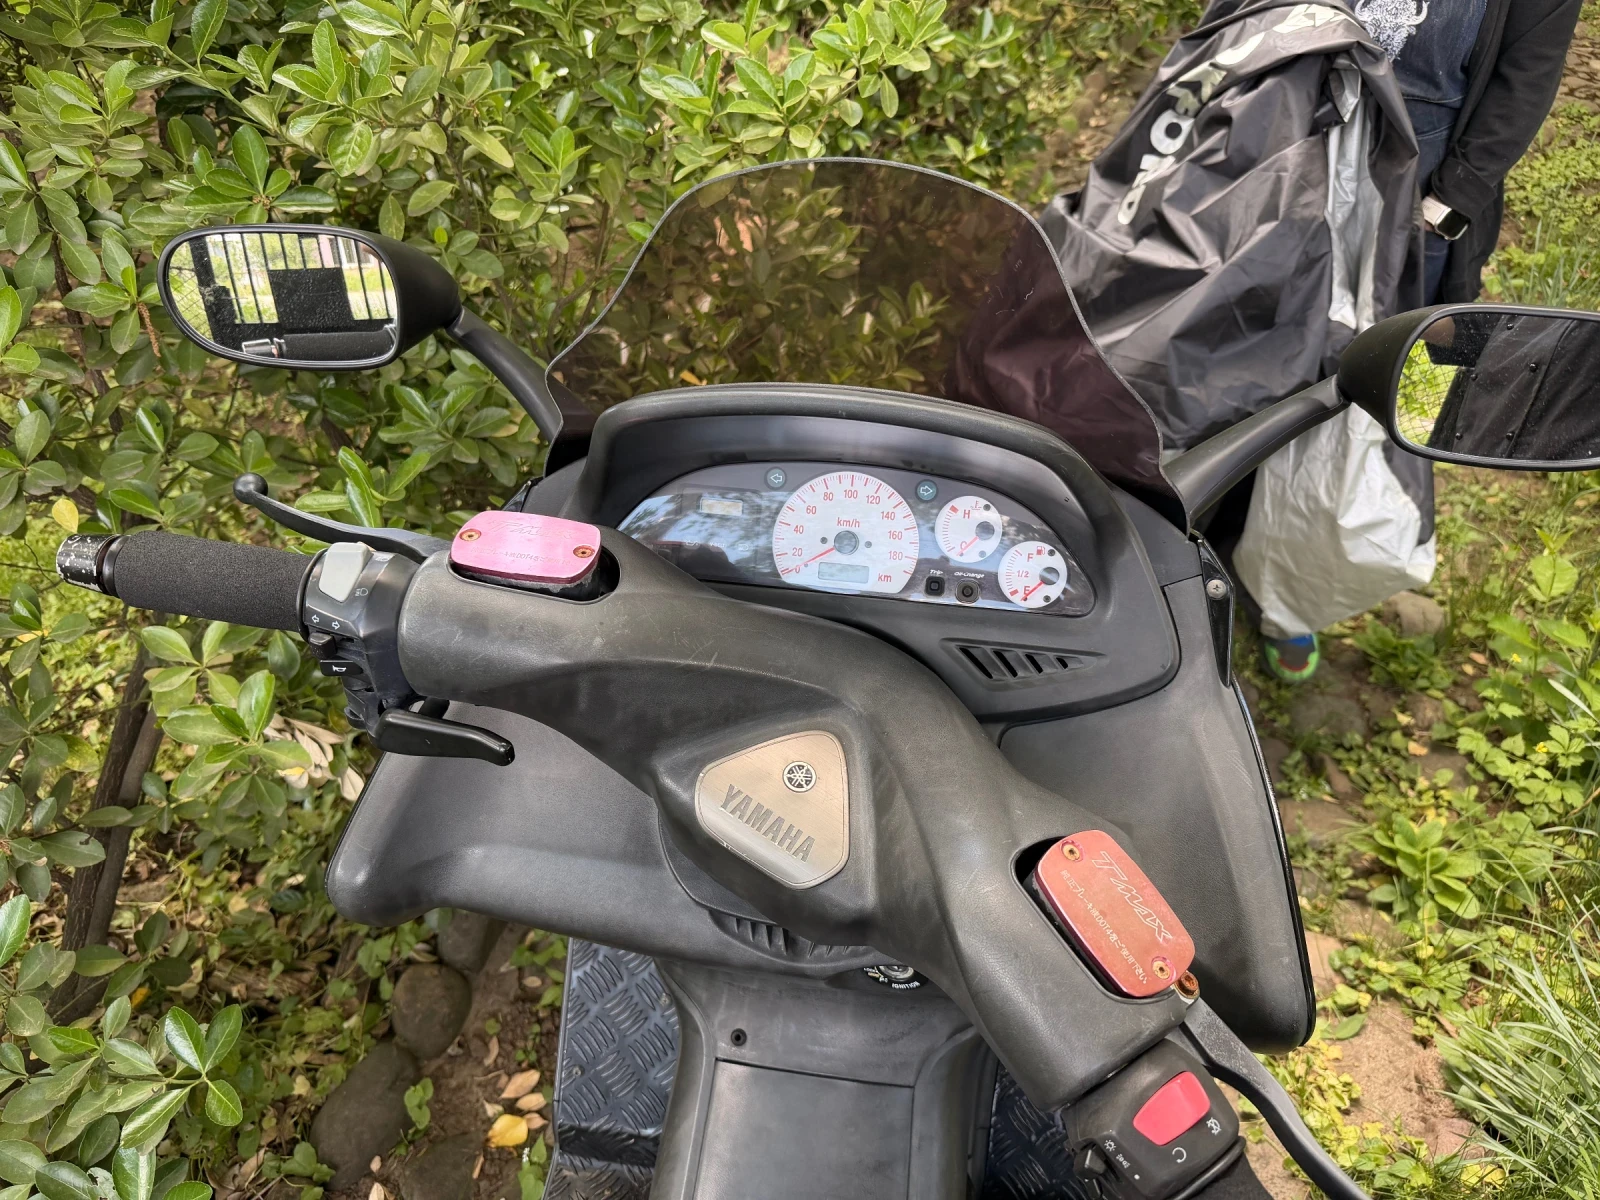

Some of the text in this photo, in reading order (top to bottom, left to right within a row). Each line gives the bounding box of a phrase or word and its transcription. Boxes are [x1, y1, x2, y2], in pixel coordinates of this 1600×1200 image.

[823, 492, 834, 502] 80
[843, 489, 858, 499] 100
[866, 495, 881, 505] 120
[806, 505, 817, 515] 60
[962, 509, 971, 519] H
[881, 511, 896, 521] 140
[837, 517, 860, 528] km/h
[793, 525, 804, 535] 40
[888, 531, 903, 541] 160
[792, 547, 803, 557] 20
[888, 550, 903, 561] 180
[1027, 553, 1034, 563] F
[877, 573, 892, 583] km
[1016, 570, 1030, 578] 1/2
[720, 783, 816, 863] YAMAHA
